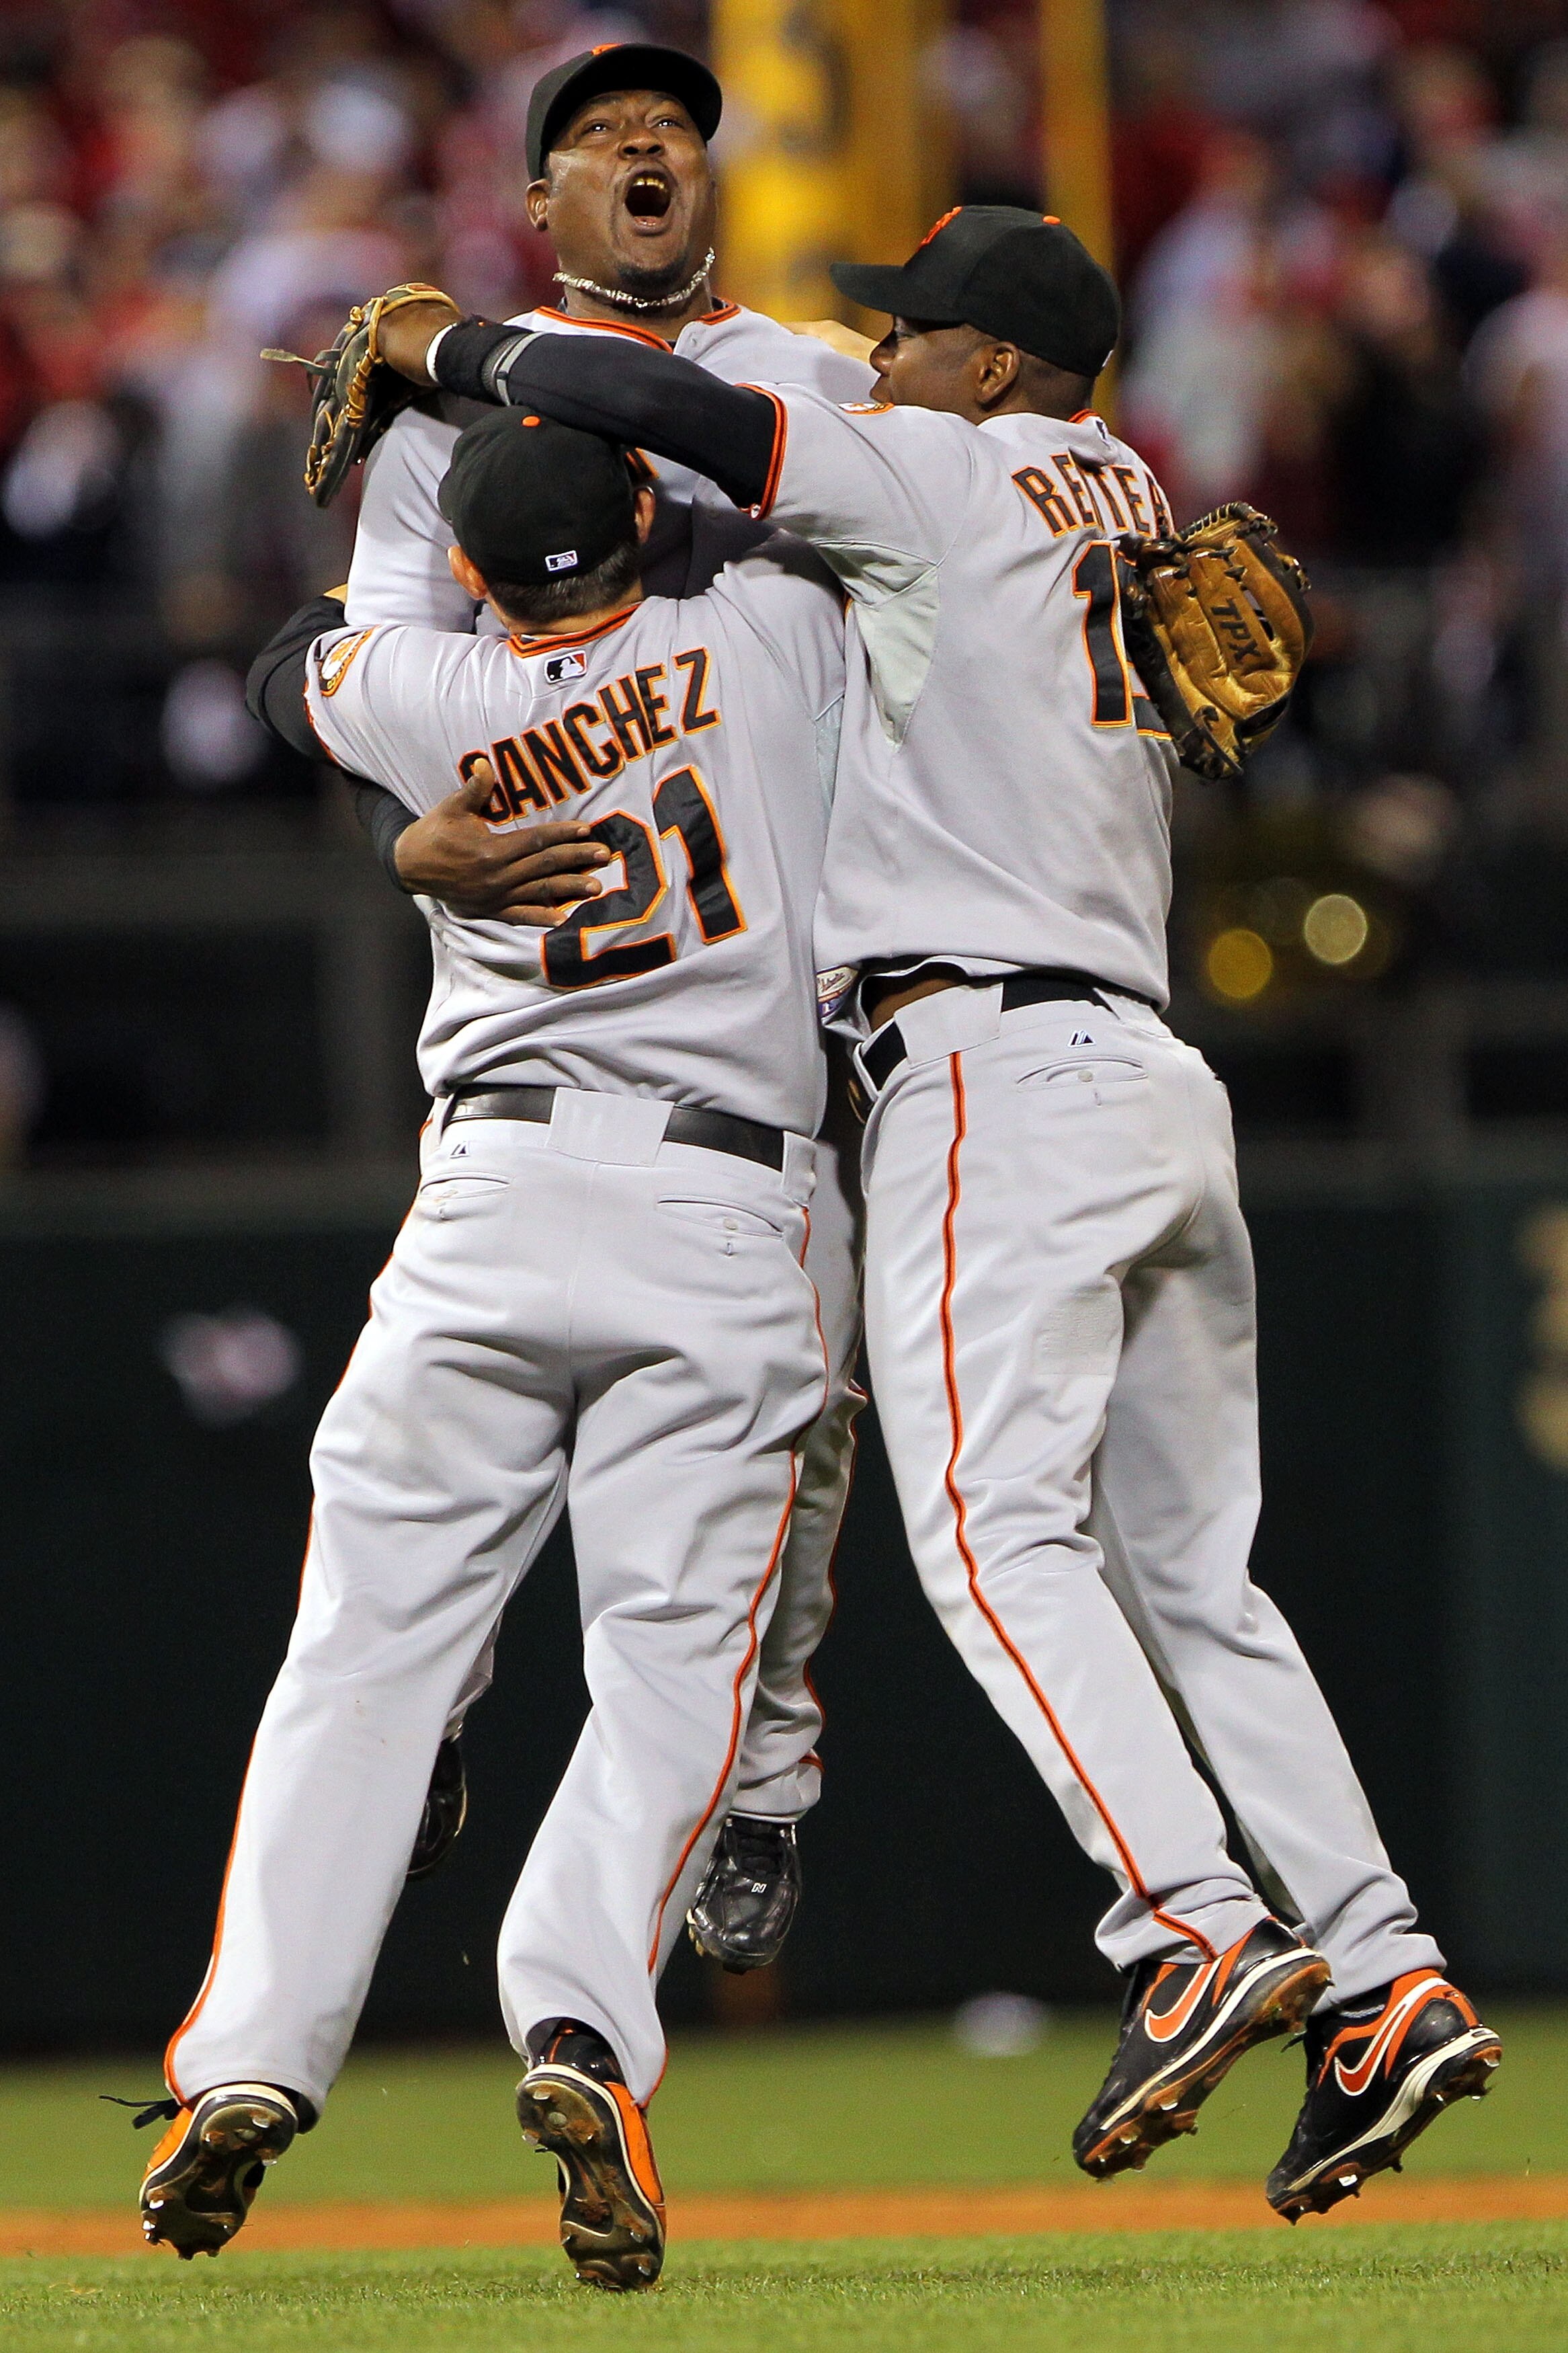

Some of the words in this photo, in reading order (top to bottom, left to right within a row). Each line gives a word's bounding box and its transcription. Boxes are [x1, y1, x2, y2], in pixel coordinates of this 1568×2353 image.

[1071, 540, 1173, 740] 1
[1210, 597, 1262, 662] TPX
[458, 646, 720, 826] SANCHEZ
[540, 764, 747, 989] 21
